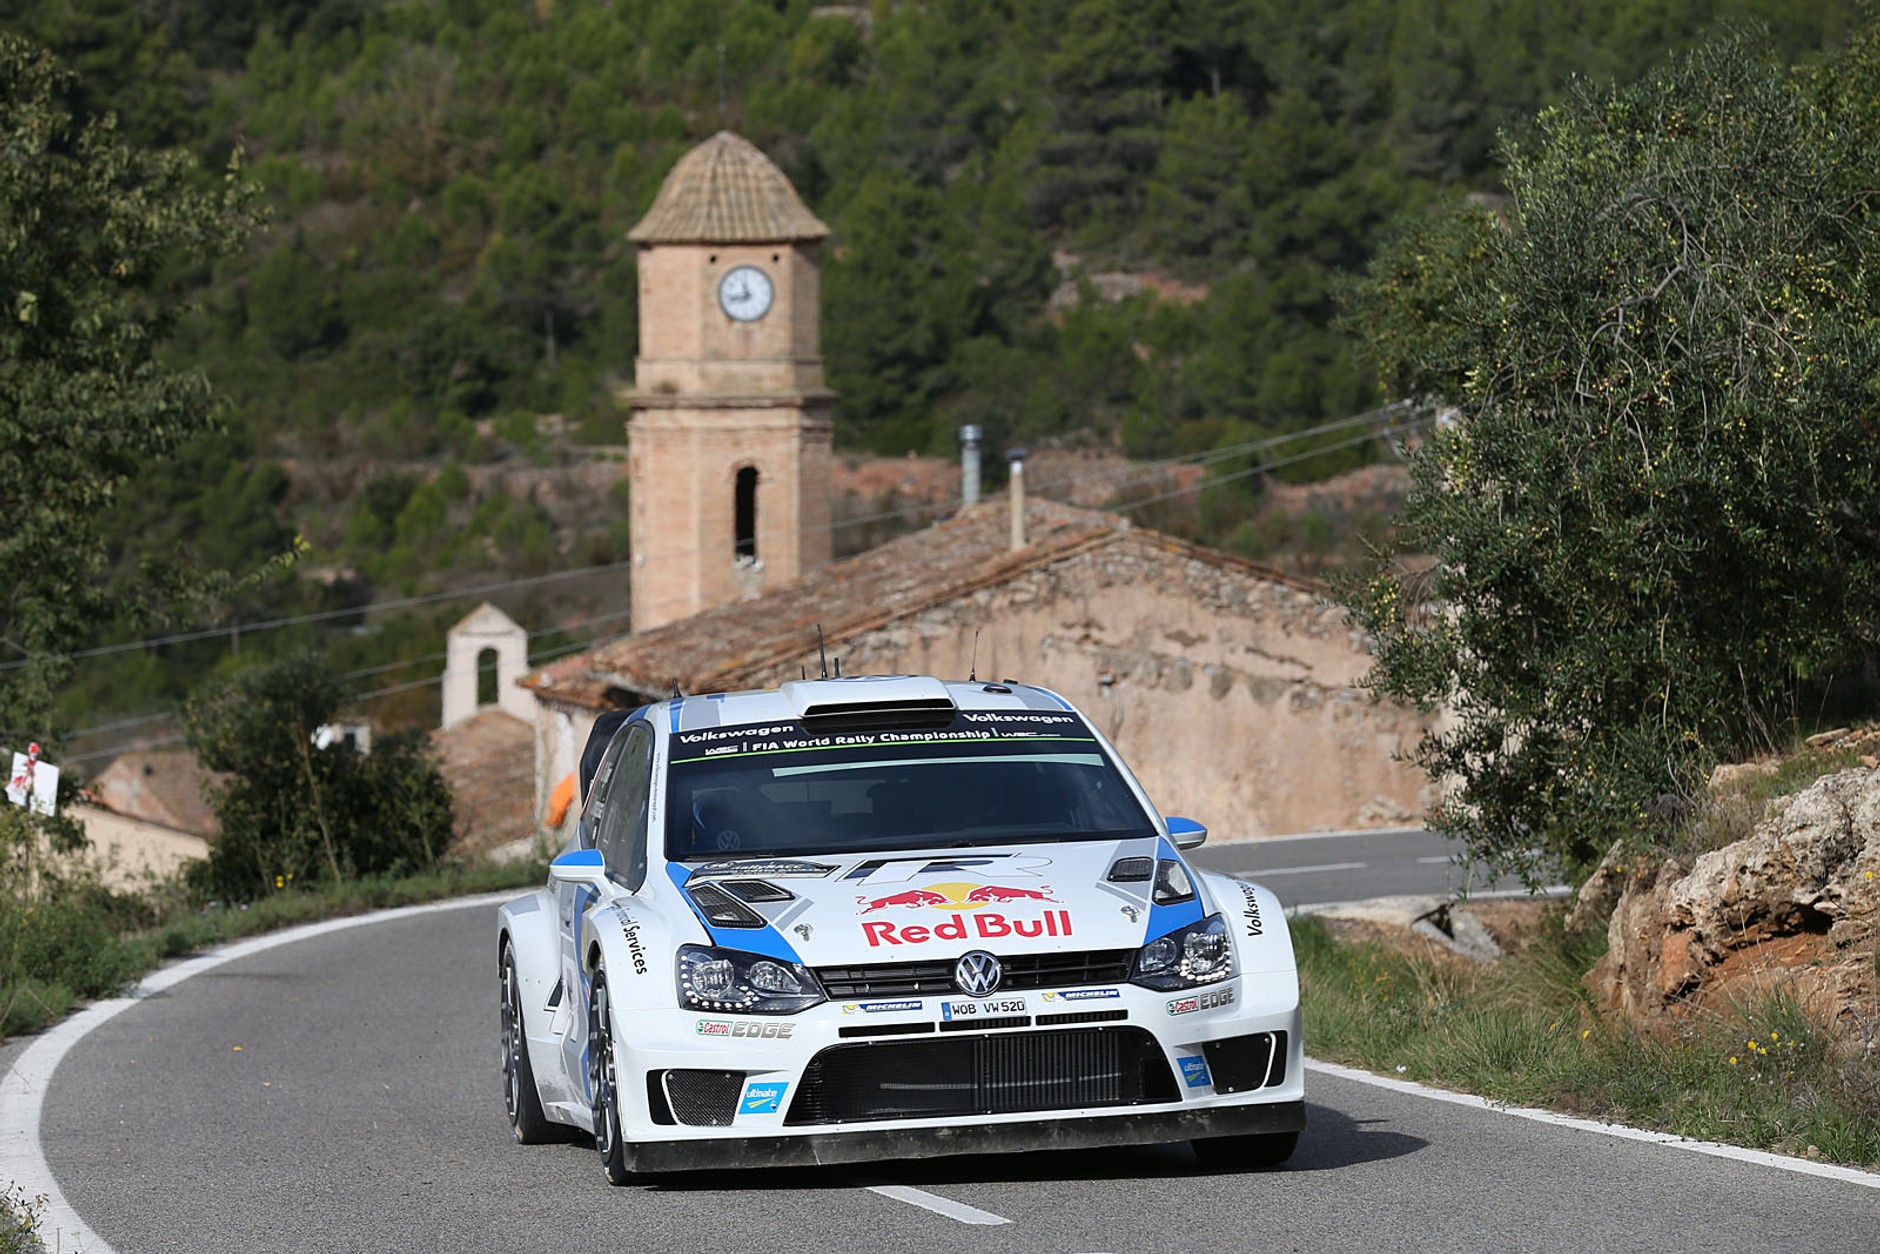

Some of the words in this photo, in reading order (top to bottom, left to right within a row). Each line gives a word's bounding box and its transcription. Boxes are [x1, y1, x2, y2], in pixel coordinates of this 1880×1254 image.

[963, 713, 1074, 724] Volkswagen
[680, 725, 794, 744] Volkswagen
[752, 742, 779, 751] FIA
[783, 737, 830, 749] World
[835, 734, 875, 745] Rally
[880, 729, 990, 742] Championship
[861, 913, 968, 948] Red
[974, 909, 1073, 938] Bull
[623, 924, 648, 975] Services
[1065, 989, 1118, 998] MICHELIN
[1175, 999, 1199, 1013] Castrol
[1200, 987, 1235, 1011] EDGE
[866, 1001, 921, 1011] MICHELIN
[952, 1003, 977, 1015] WOB
[983, 1002, 999, 1013] VW
[1001, 1000, 1025, 1012] 520
[703, 1021, 729, 1034] Castrol
[731, 1021, 796, 1039] EDGE
[746, 1087, 778, 1099] ultimate
